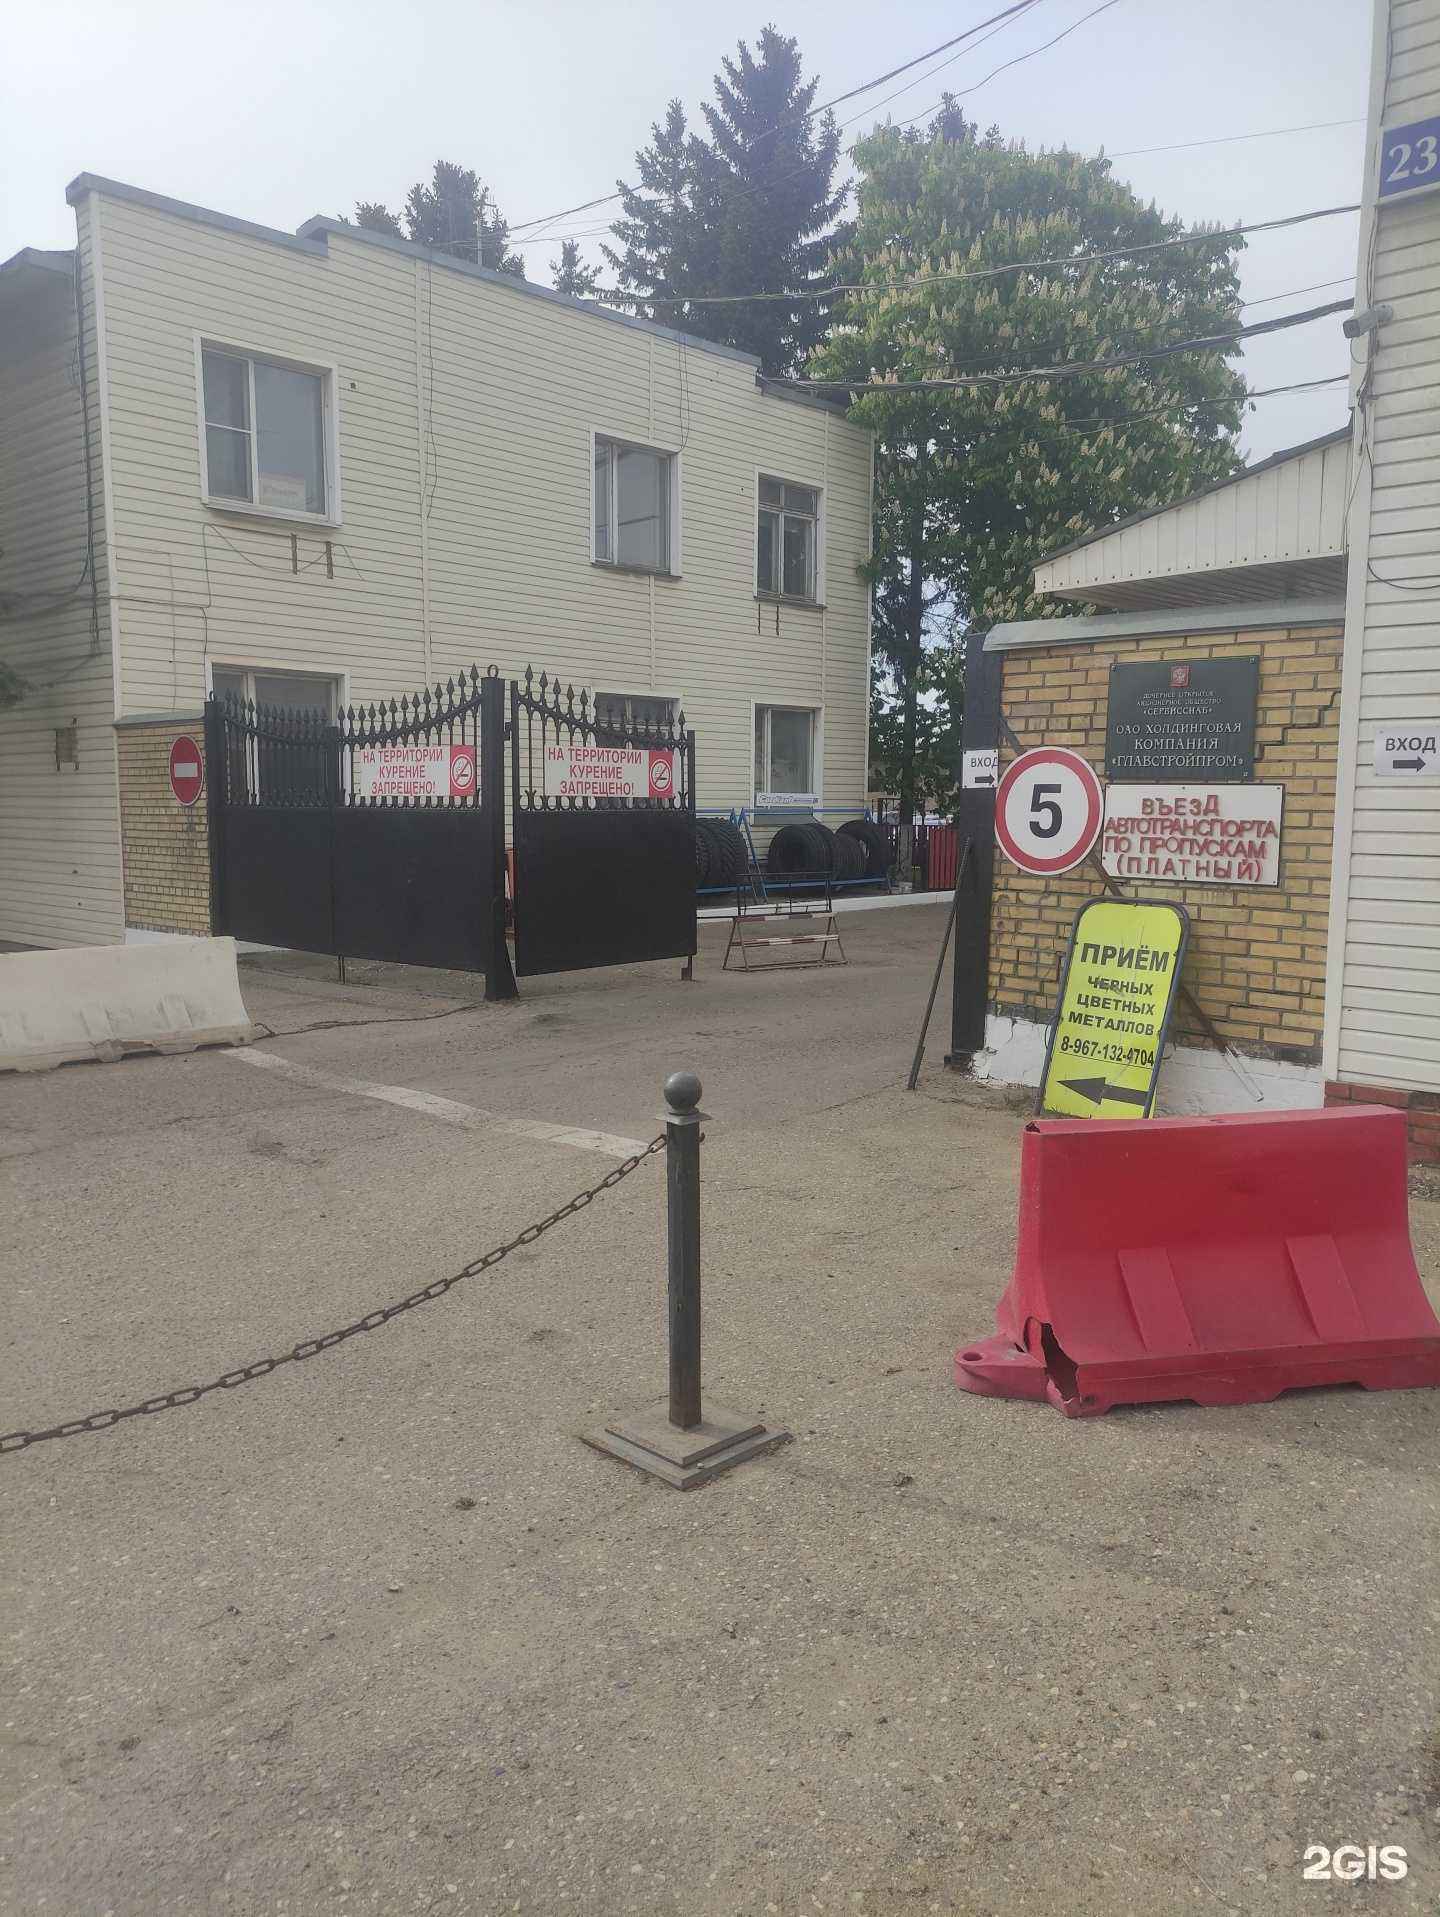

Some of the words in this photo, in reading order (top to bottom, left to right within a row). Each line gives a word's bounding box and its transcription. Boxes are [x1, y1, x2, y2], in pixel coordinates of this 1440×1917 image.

[1386, 135, 1438, 182] 23
[1116, 724, 1141, 734] ОАО
[1146, 723, 1241, 734] ХОЛДИНГОВАЯ
[1135, 738, 1219, 750] КОМПАНИЯ
[1385, 737, 1437, 754] ВХОД
[363, 751, 375, 763] НА
[378, 748, 443, 763] ТЕРРИТОРИИ
[548, 747, 564, 761] НА
[568, 748, 642, 764] ТЕРРИТОРИИ
[1112, 753, 1244, 767] «ГЛАВСТРОЙПРОМ»
[379, 765, 426, 778] КУРЕНИЕ
[569, 765, 623, 779] КУРЕНИЕ
[371, 781, 436, 796] ЗАПРЕЩЕНО!
[560, 781, 634, 797] ЗАПРЕЩЕНО!
[1028, 783, 1063, 839] 5
[1141, 794, 1220, 817] ВЪЕЗД
[1104, 816, 1279, 838] АВТОТРАНСПОРТА
[1104, 836, 1131, 853] ПО
[1139, 836, 1267, 859] ПРОПУСКАМ
[1116, 854, 1263, 882] (ПЛАТНЫЙ)
[1080, 942, 1170, 972] ПРИЁМ
[1076, 993, 1156, 1016] ЦВЕТНЫХ
[1068, 1011, 1155, 1036] МЕТАЛЛОВ
[1060, 1035, 1154, 1067] 8-967-132-4704
